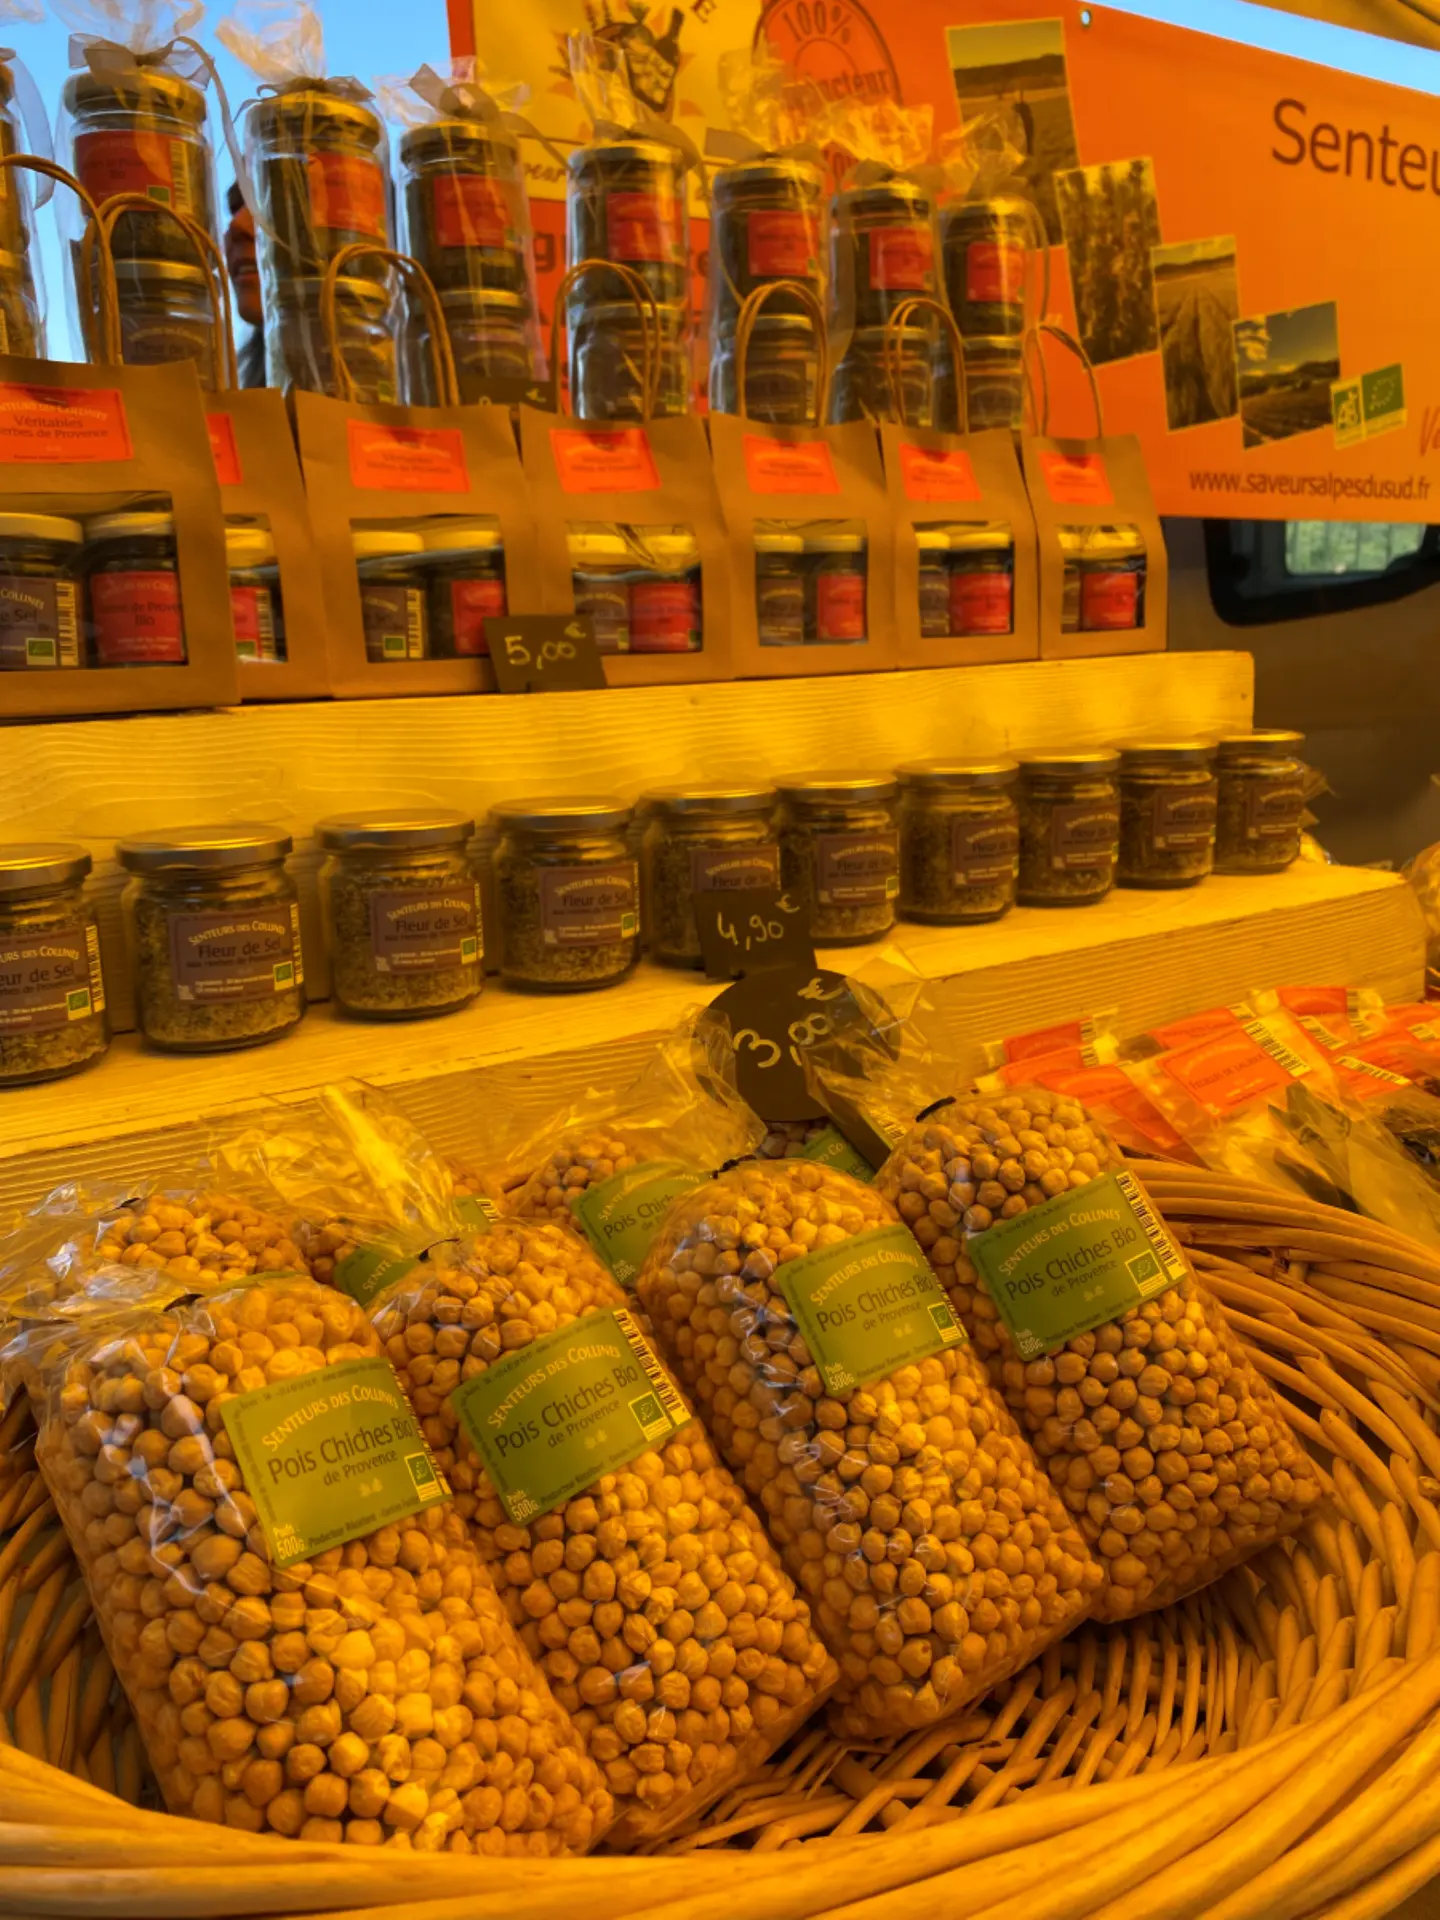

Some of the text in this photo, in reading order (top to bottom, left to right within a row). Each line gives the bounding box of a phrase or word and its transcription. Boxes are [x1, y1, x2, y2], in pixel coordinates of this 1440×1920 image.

[783, 1, 853, 45] 100%
[0, 427, 34, 438] erbes
[1189, 471, 1432, 503] www.saveursalpesdusud.fr
[14, 608, 37, 622] Sel
[504, 635, 577, 671] 5,00
[198, 936, 281, 959] Fleur de Sel
[717, 911, 784, 951] 4,90
[0, 962, 75, 986] eur de Sel
[603, 1213, 637, 1240] Pois
[997, 1208, 1121, 1277] SENTEURS DES COLLINES
[810, 1262, 862, 1306] SENTEURS
[862, 1255, 879, 1269] DES
[1004, 1224, 1138, 1302] Pois Chiches Bio
[1051, 1259, 1119, 1298] de Provence
[816, 1273, 933, 1333] Pois Chiches Bio
[863, 1300, 921, 1331] de Provence
[487, 1343, 622, 1429] SENTEURS DES COLLINES
[262, 1398, 329, 1453] SENTEURS
[330, 1391, 351, 1409] DES
[493, 1363, 639, 1458] Pois Chiches Bio
[547, 1398, 621, 1449] de Provence
[267, 1416, 414, 1485] Pois Chiches Bio
[323, 1449, 398, 1487] de Provence
